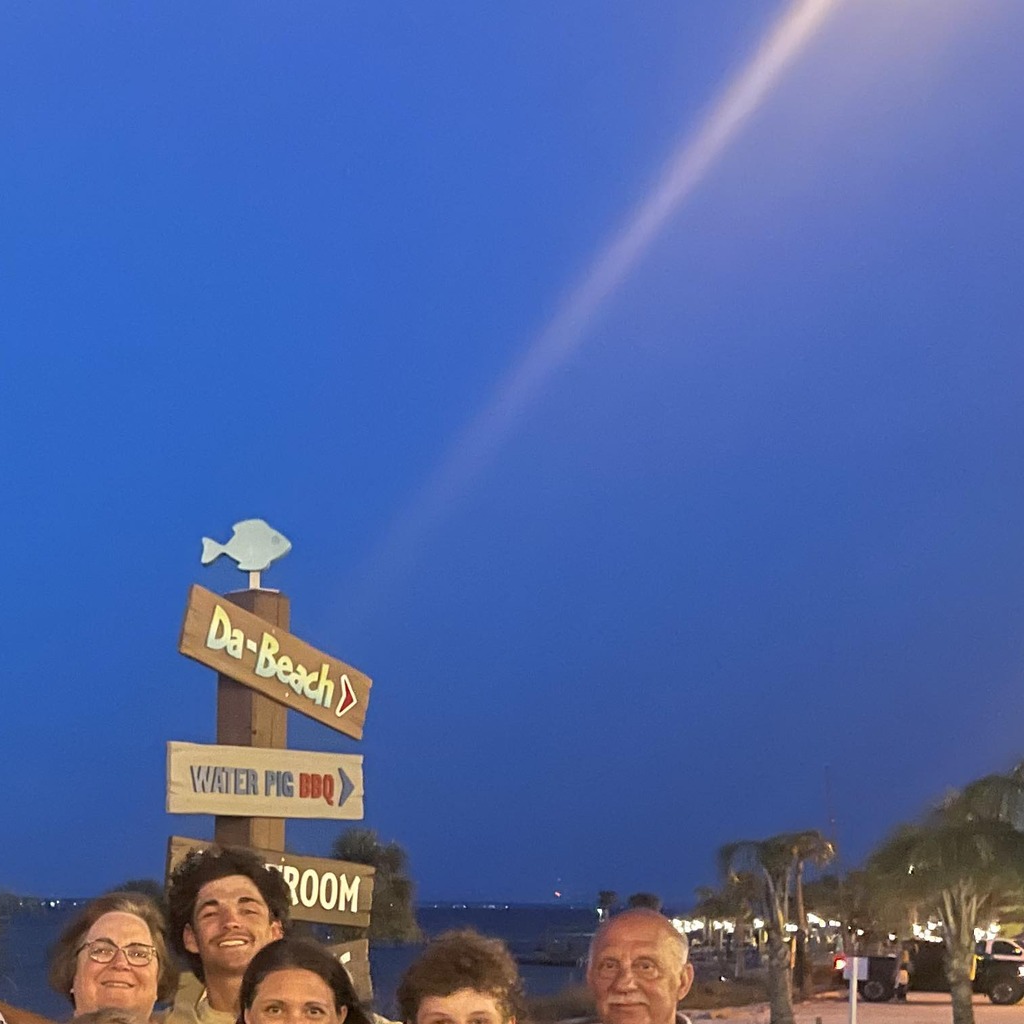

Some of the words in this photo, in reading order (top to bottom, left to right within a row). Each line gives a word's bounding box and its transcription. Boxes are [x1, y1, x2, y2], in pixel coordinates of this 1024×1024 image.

[206, 604, 335, 709] Da-Beach
[190, 765, 259, 796] WATER
[264, 769, 294, 798] PIG
[299, 772, 335, 806] BBQ
[265, 863, 362, 914] ROOM
